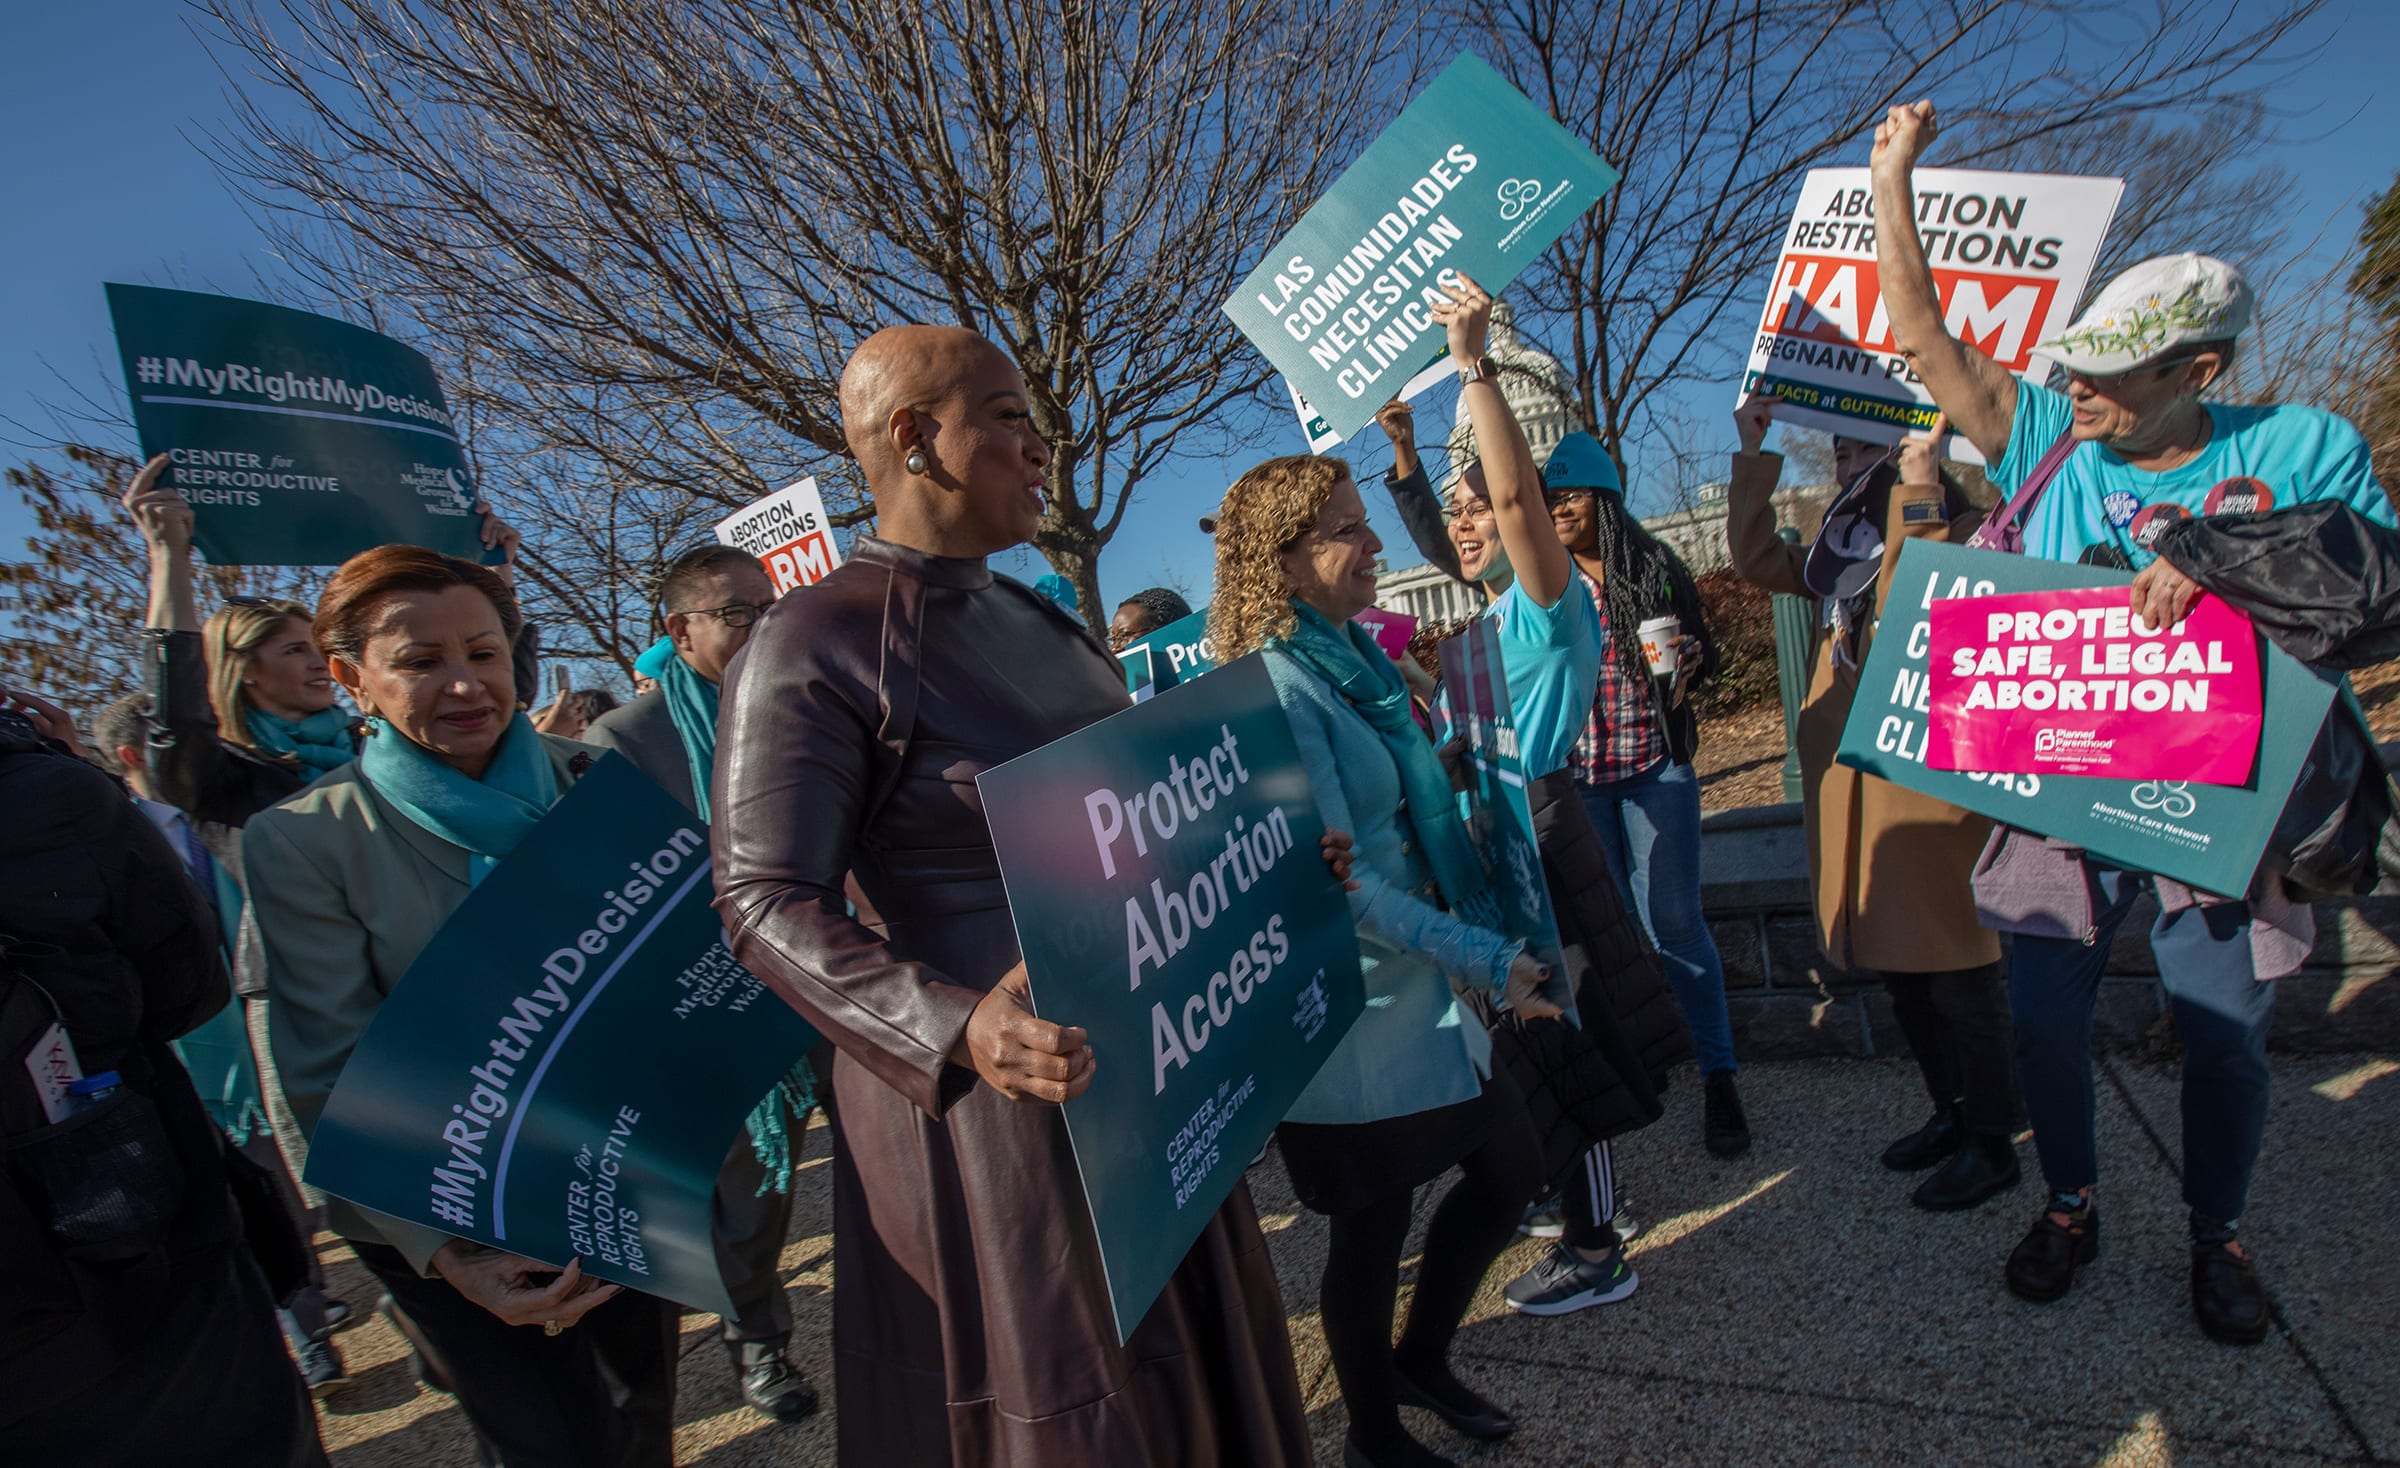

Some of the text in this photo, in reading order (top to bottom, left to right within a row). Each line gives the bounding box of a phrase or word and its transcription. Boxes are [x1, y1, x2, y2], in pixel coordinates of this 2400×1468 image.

[1498, 180, 1569, 248] Abortion Care Network
[1824, 188, 2027, 230] ABTION
[1283, 144, 1478, 343] COMUNIDADES
[1793, 220, 2063, 271] RESTRTIONS
[1258, 255, 1315, 316] LAS
[1308, 214, 1463, 372] NECESITAN
[1336, 267, 1466, 399] CLÍNICAS
[1755, 336, 1879, 377] PREGNANT
[136, 355, 452, 427] #MyRightMyDecision
[1776, 383, 1819, 405] FACTS
[1821, 394, 1836, 409] at
[1315, 420, 1328, 433] Ge
[169, 448, 295, 470] CENTER for
[173, 468, 340, 492] REPRODUCTIVE
[176, 487, 262, 507] RIGHTS
[730, 500, 794, 545] ABORTION
[741, 512, 816, 556] TRICTIONS
[769, 536, 831, 600] RM
[1951, 641, 2233, 680] SAFE, LEGAL
[1964, 679, 2209, 713] ABORTION
[2055, 737, 2113, 750] Parenthood
[2056, 728, 2095, 739] Planned
[1084, 723, 1249, 880] Protect
[2092, 801, 2211, 844] Abortion Care Network
[1124, 805, 1293, 990] Abortion
[673, 951, 737, 1019] Medical
[676, 943, 724, 988] Hope
[702, 962, 746, 1007] Grou
[728, 980, 768, 1012] Wom
[1152, 913, 1290, 1096] Access
[430, 826, 704, 1229] #MyRightMyDecision
[1167, 1098, 1216, 1162] CENTER
[1171, 1073, 1256, 1187] REPRODUCTIVE
[568, 1143, 595, 1256] CENTER for
[593, 1105, 641, 1266] REPRODUCTIVE
[1175, 1144, 1220, 1210] RIGHTS
[618, 1207, 650, 1276] RIGHTS
